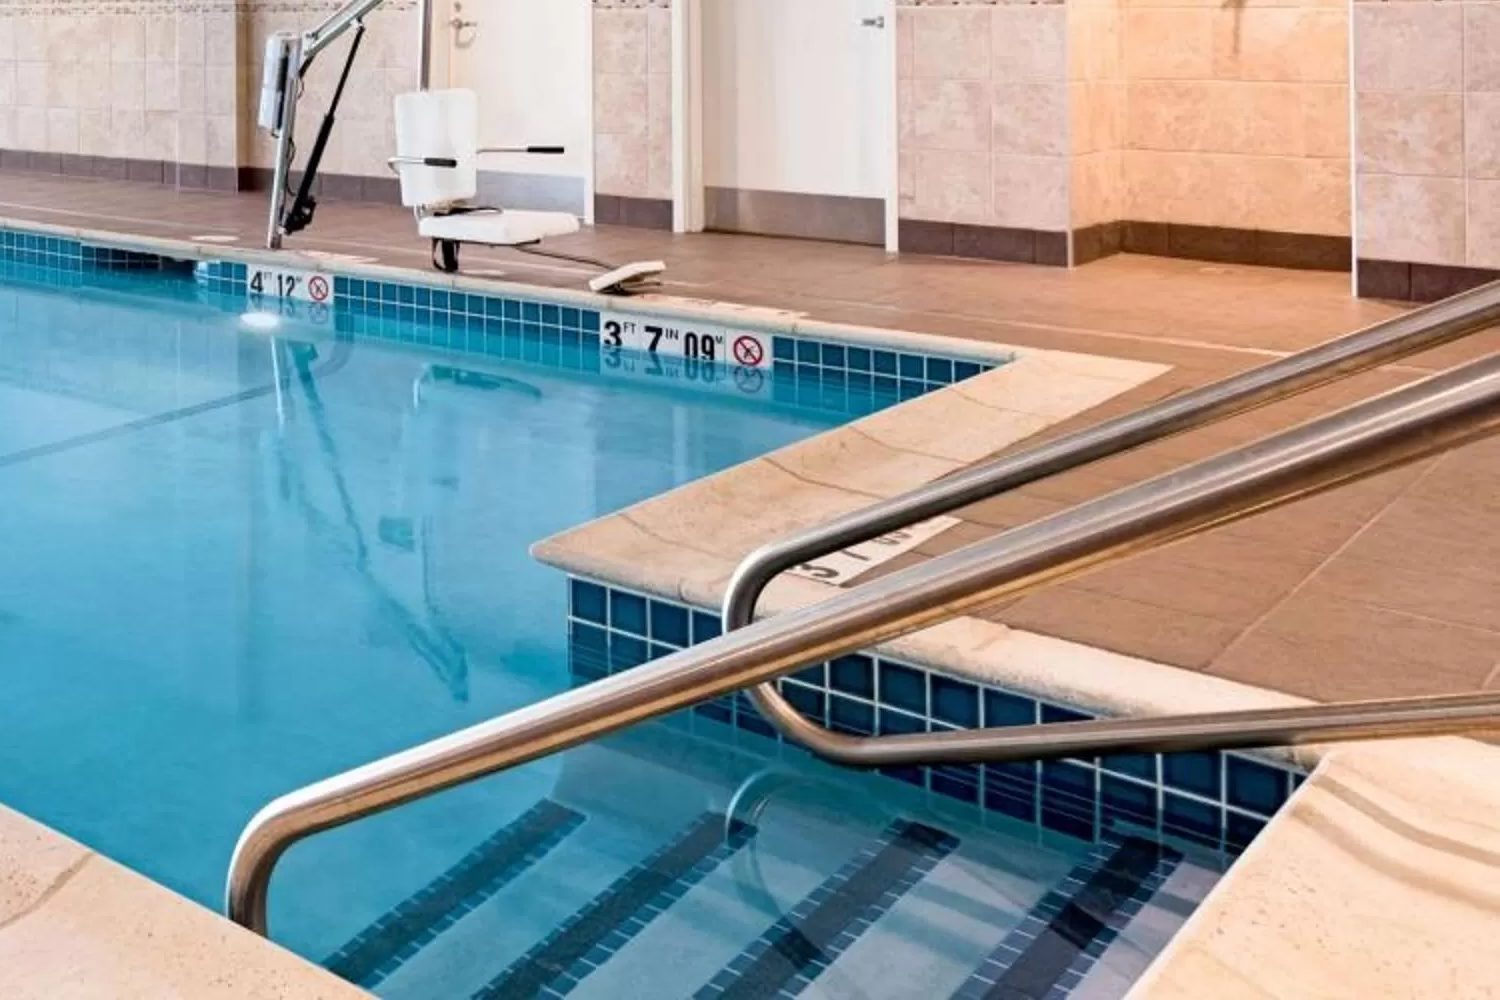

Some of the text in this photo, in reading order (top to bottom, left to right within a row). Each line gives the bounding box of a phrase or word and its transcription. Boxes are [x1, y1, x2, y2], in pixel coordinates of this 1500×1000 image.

[250, 271, 264, 292] 4
[277, 273, 295, 296] 12
[603, 320, 622, 346] 3
[644, 325, 664, 352] 7
[665, 327, 680, 341] IN
